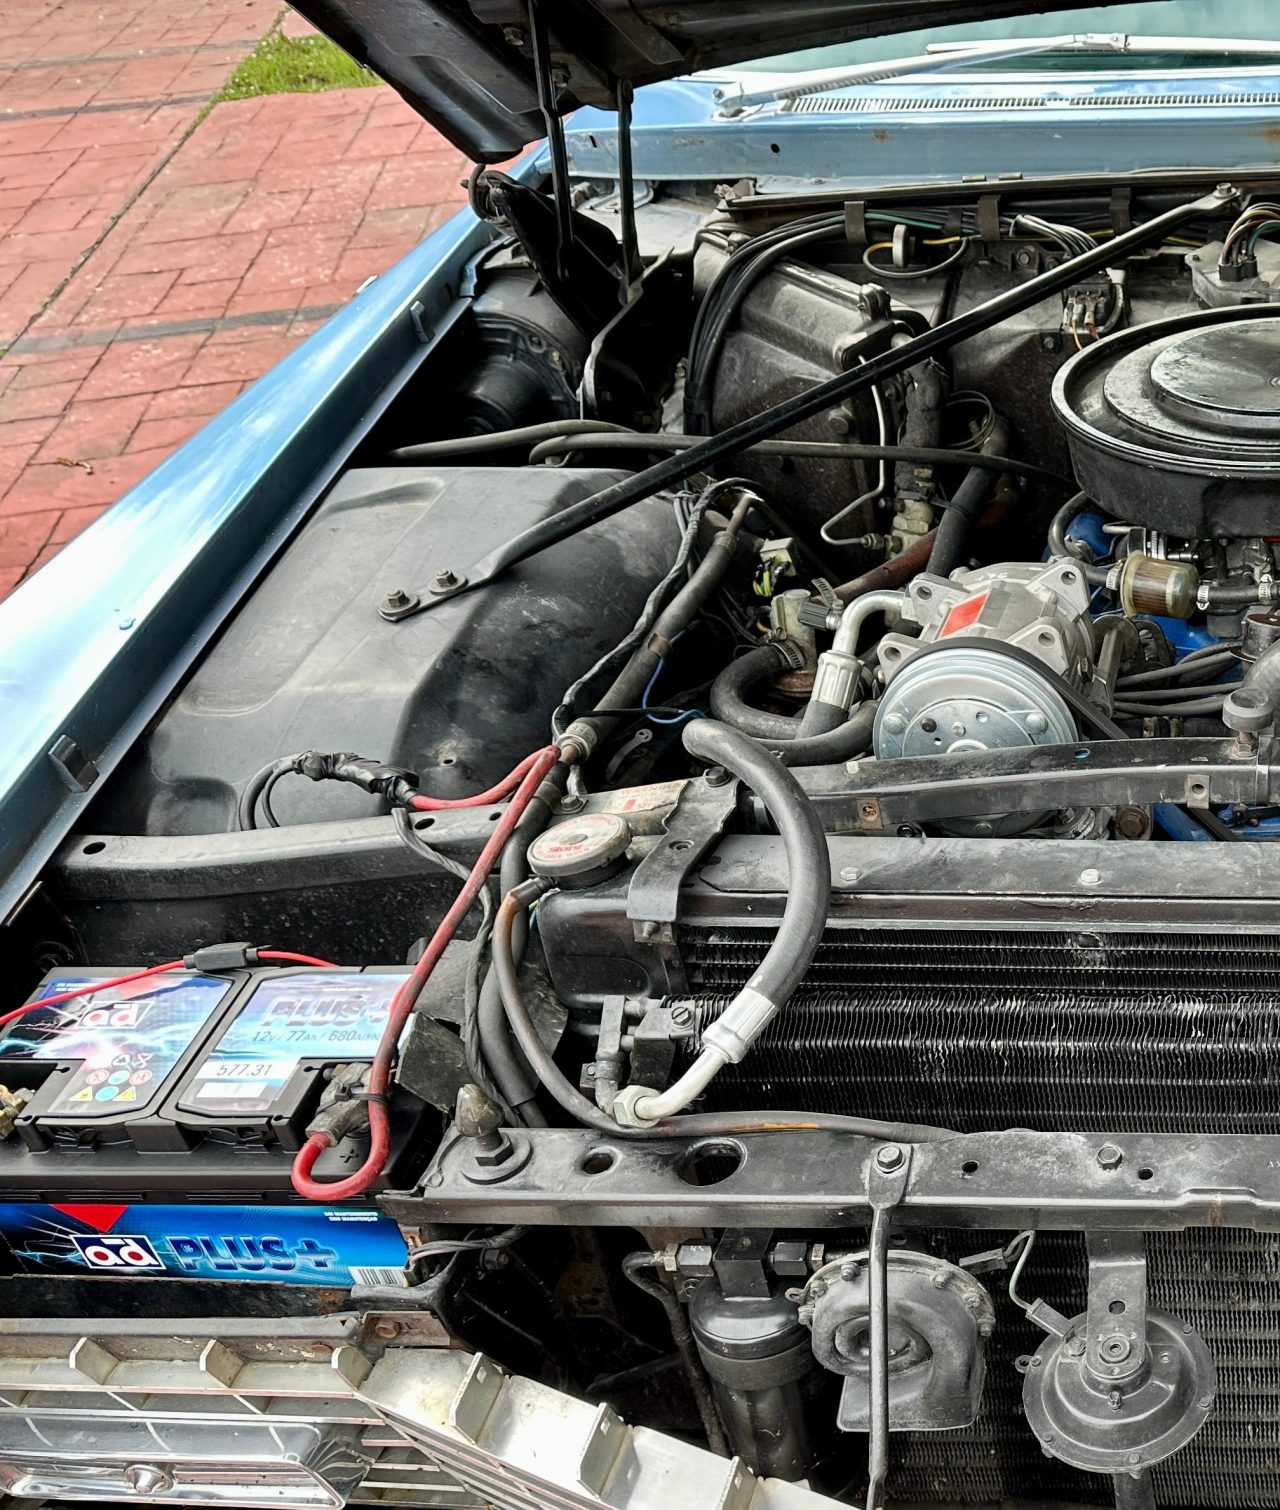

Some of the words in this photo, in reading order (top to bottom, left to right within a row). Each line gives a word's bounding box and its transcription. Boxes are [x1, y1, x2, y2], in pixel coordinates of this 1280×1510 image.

[216, 1063, 273, 1076] 577.31
[84, 1238, 160, 1267] ad
[165, 1234, 337, 1271] PLUS+
